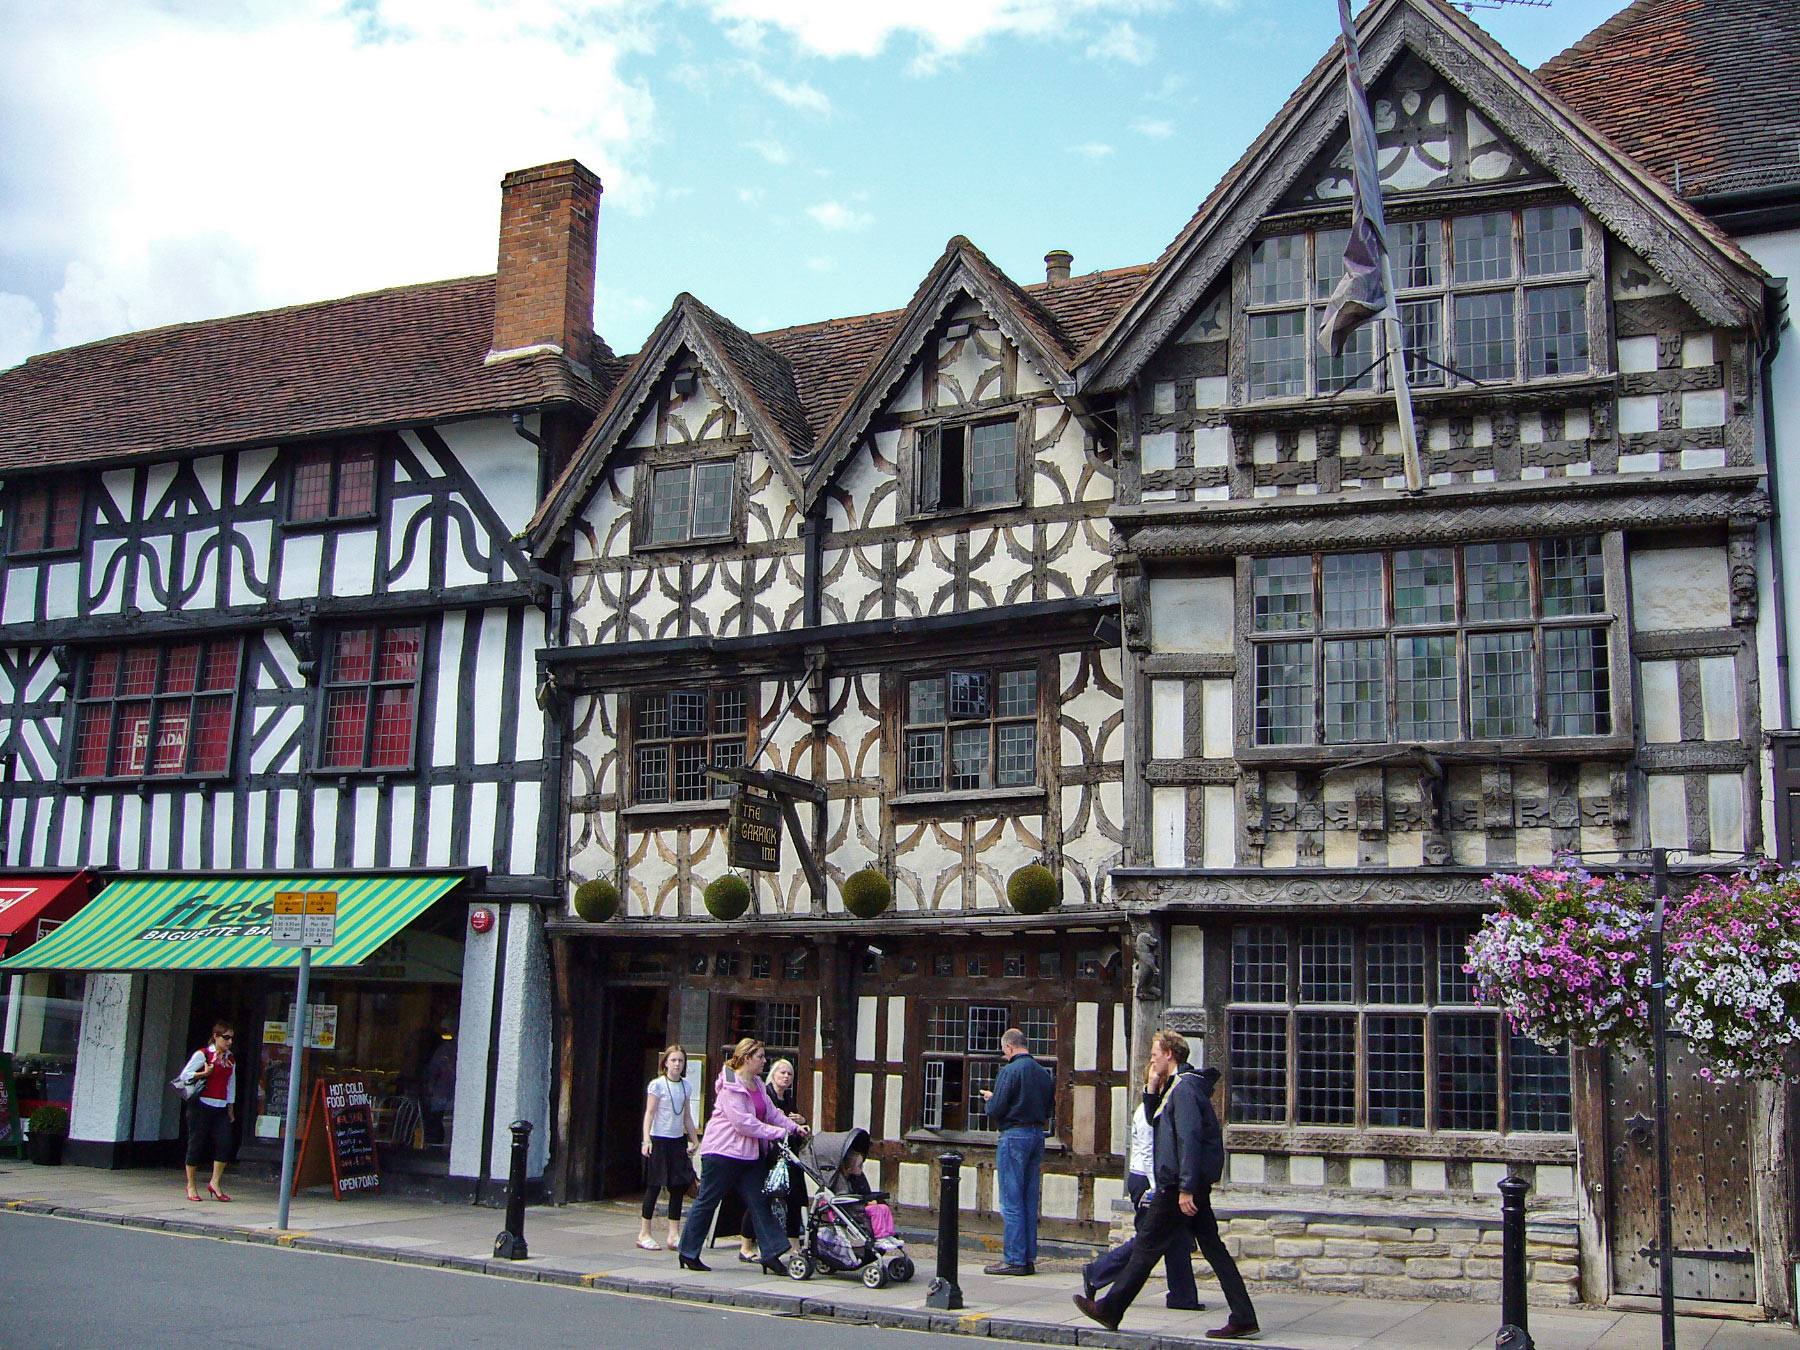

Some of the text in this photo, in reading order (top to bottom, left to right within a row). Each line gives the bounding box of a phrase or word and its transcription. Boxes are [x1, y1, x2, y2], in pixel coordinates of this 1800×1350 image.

[136, 732, 183, 747] STADA
[741, 822, 777, 845] GARRICK
[155, 895, 273, 926] fres
[142, 926, 273, 940] BAGUETTE BA
[329, 1082, 364, 1096] HOT COLD
[326, 1096, 346, 1108] FOOD
[339, 1177, 358, 1191] OPEN
[362, 1174, 379, 1188] DAYS
